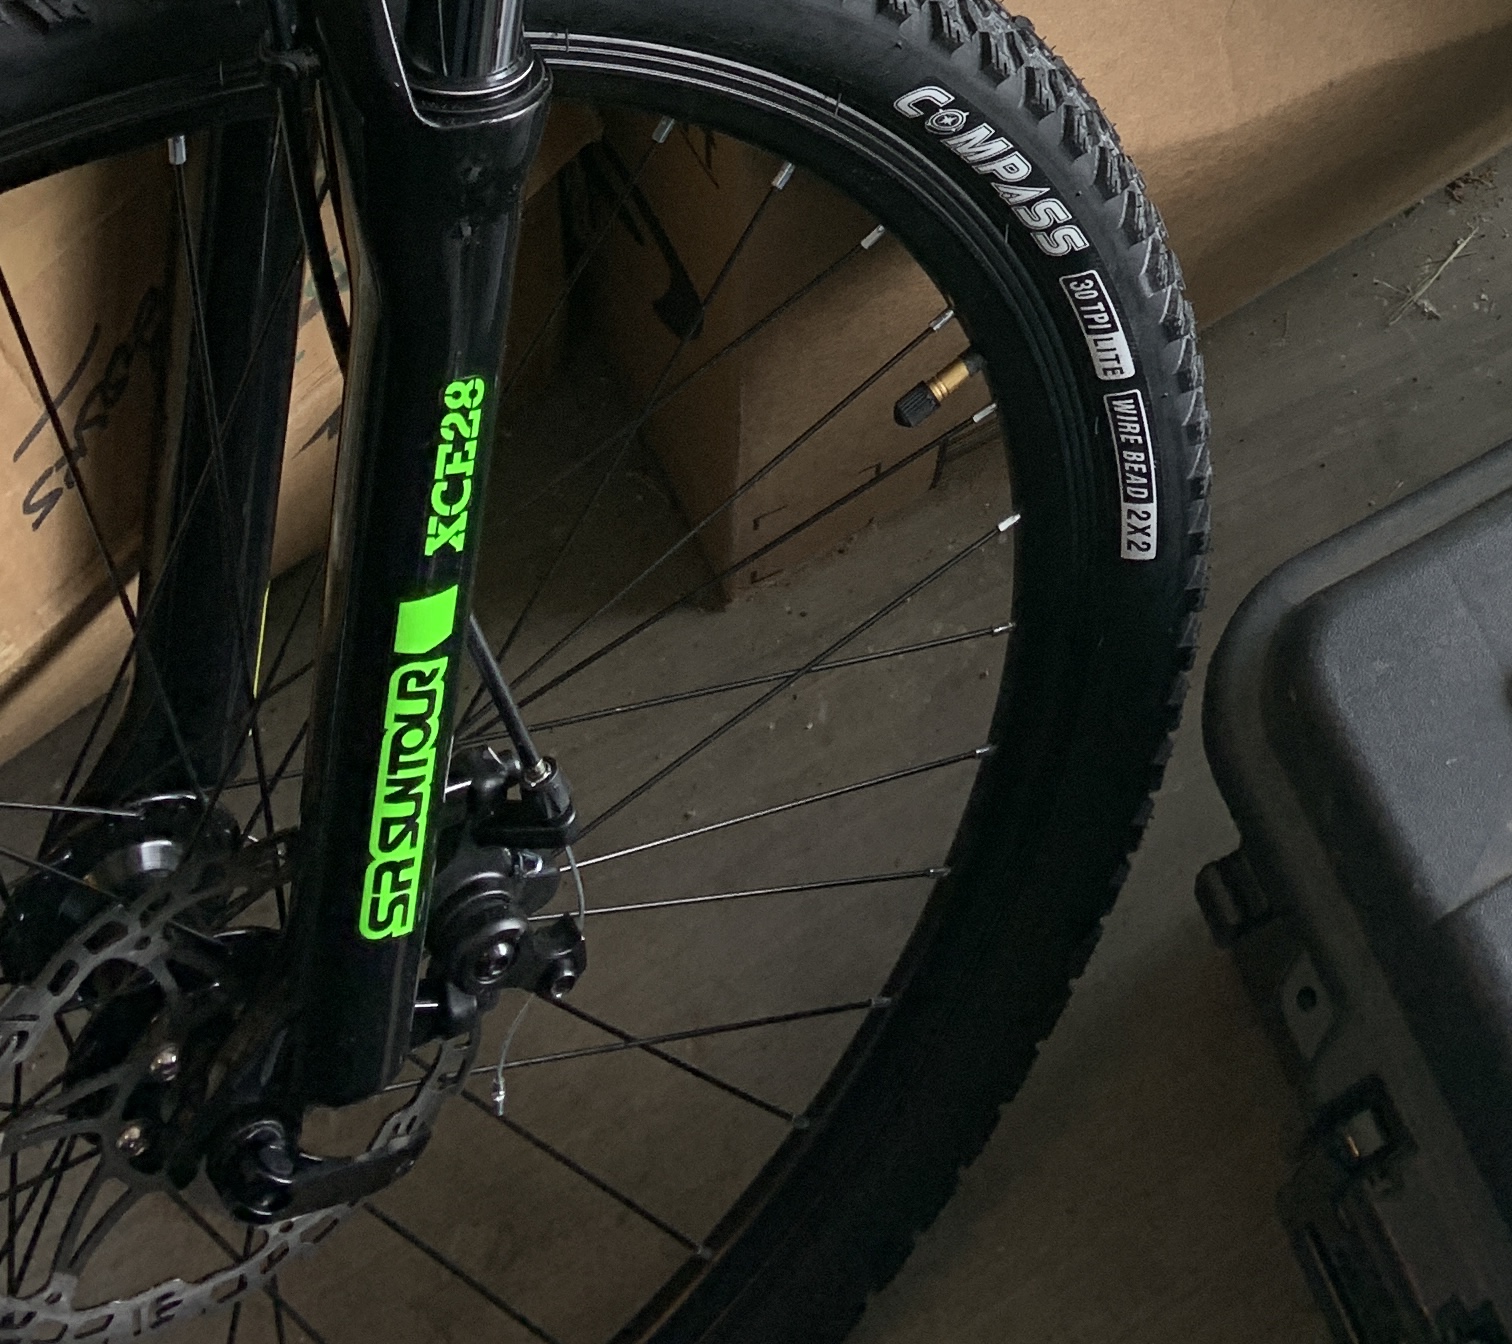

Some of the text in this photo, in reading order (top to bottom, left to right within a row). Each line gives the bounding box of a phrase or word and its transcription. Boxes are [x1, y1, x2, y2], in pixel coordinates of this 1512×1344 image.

[894, 85, 1090, 258] COMPASS
[1069, 276, 1126, 380] 30 TPI LITE
[425, 377, 486, 556] XCE28
[1112, 397, 1152, 553] WIRE BEAD 2X2
[371, 665, 440, 932] SR SUNTOUR
